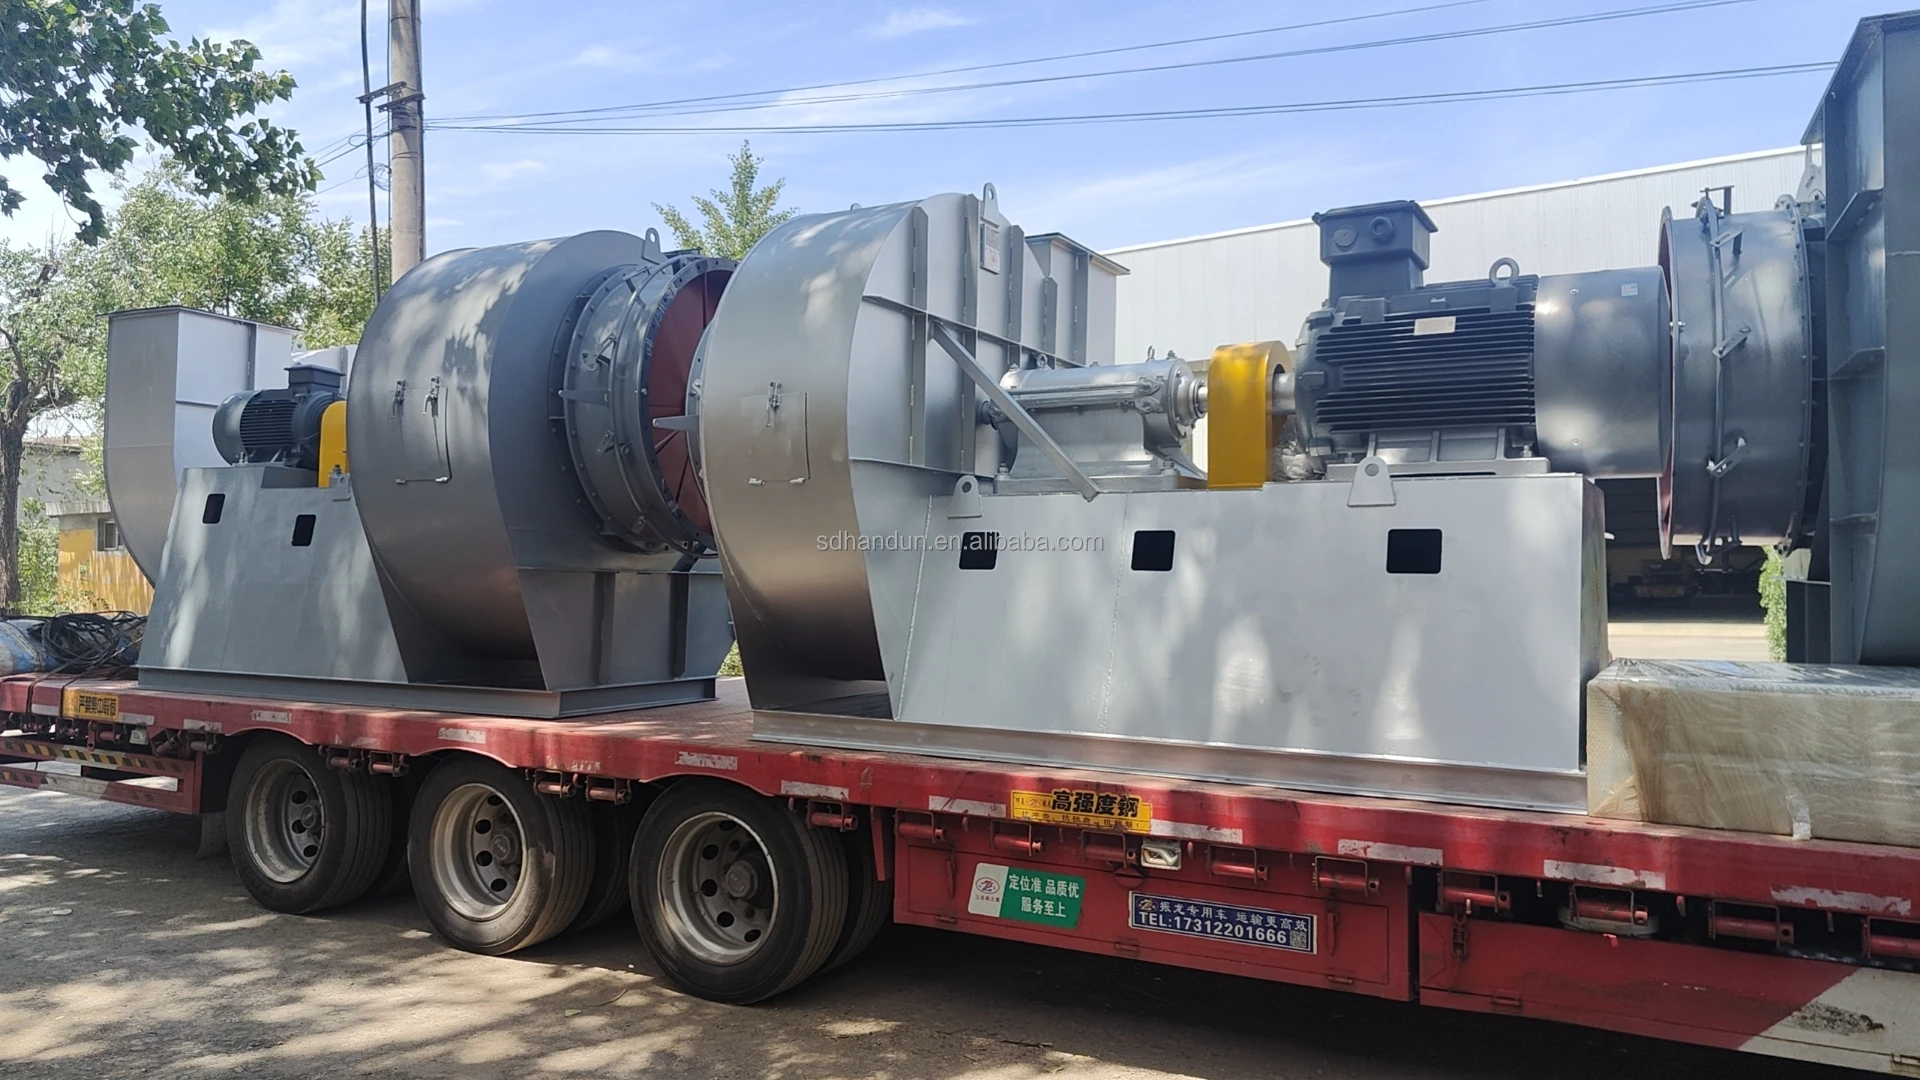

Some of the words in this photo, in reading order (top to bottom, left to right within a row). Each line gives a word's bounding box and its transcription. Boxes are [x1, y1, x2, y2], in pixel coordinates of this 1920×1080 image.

[1052, 790, 1140, 818] 高强度钢
[1009, 874, 1042, 893] 定位准
[1045, 879, 1079, 898] 品质优
[1021, 896, 1066, 917] 服务至上
[1159, 901, 1228, 920] 振龙专用车
[1235, 911, 1308, 931] 运输更高效
[1139, 912, 1287, 944] TEL:17312201666
